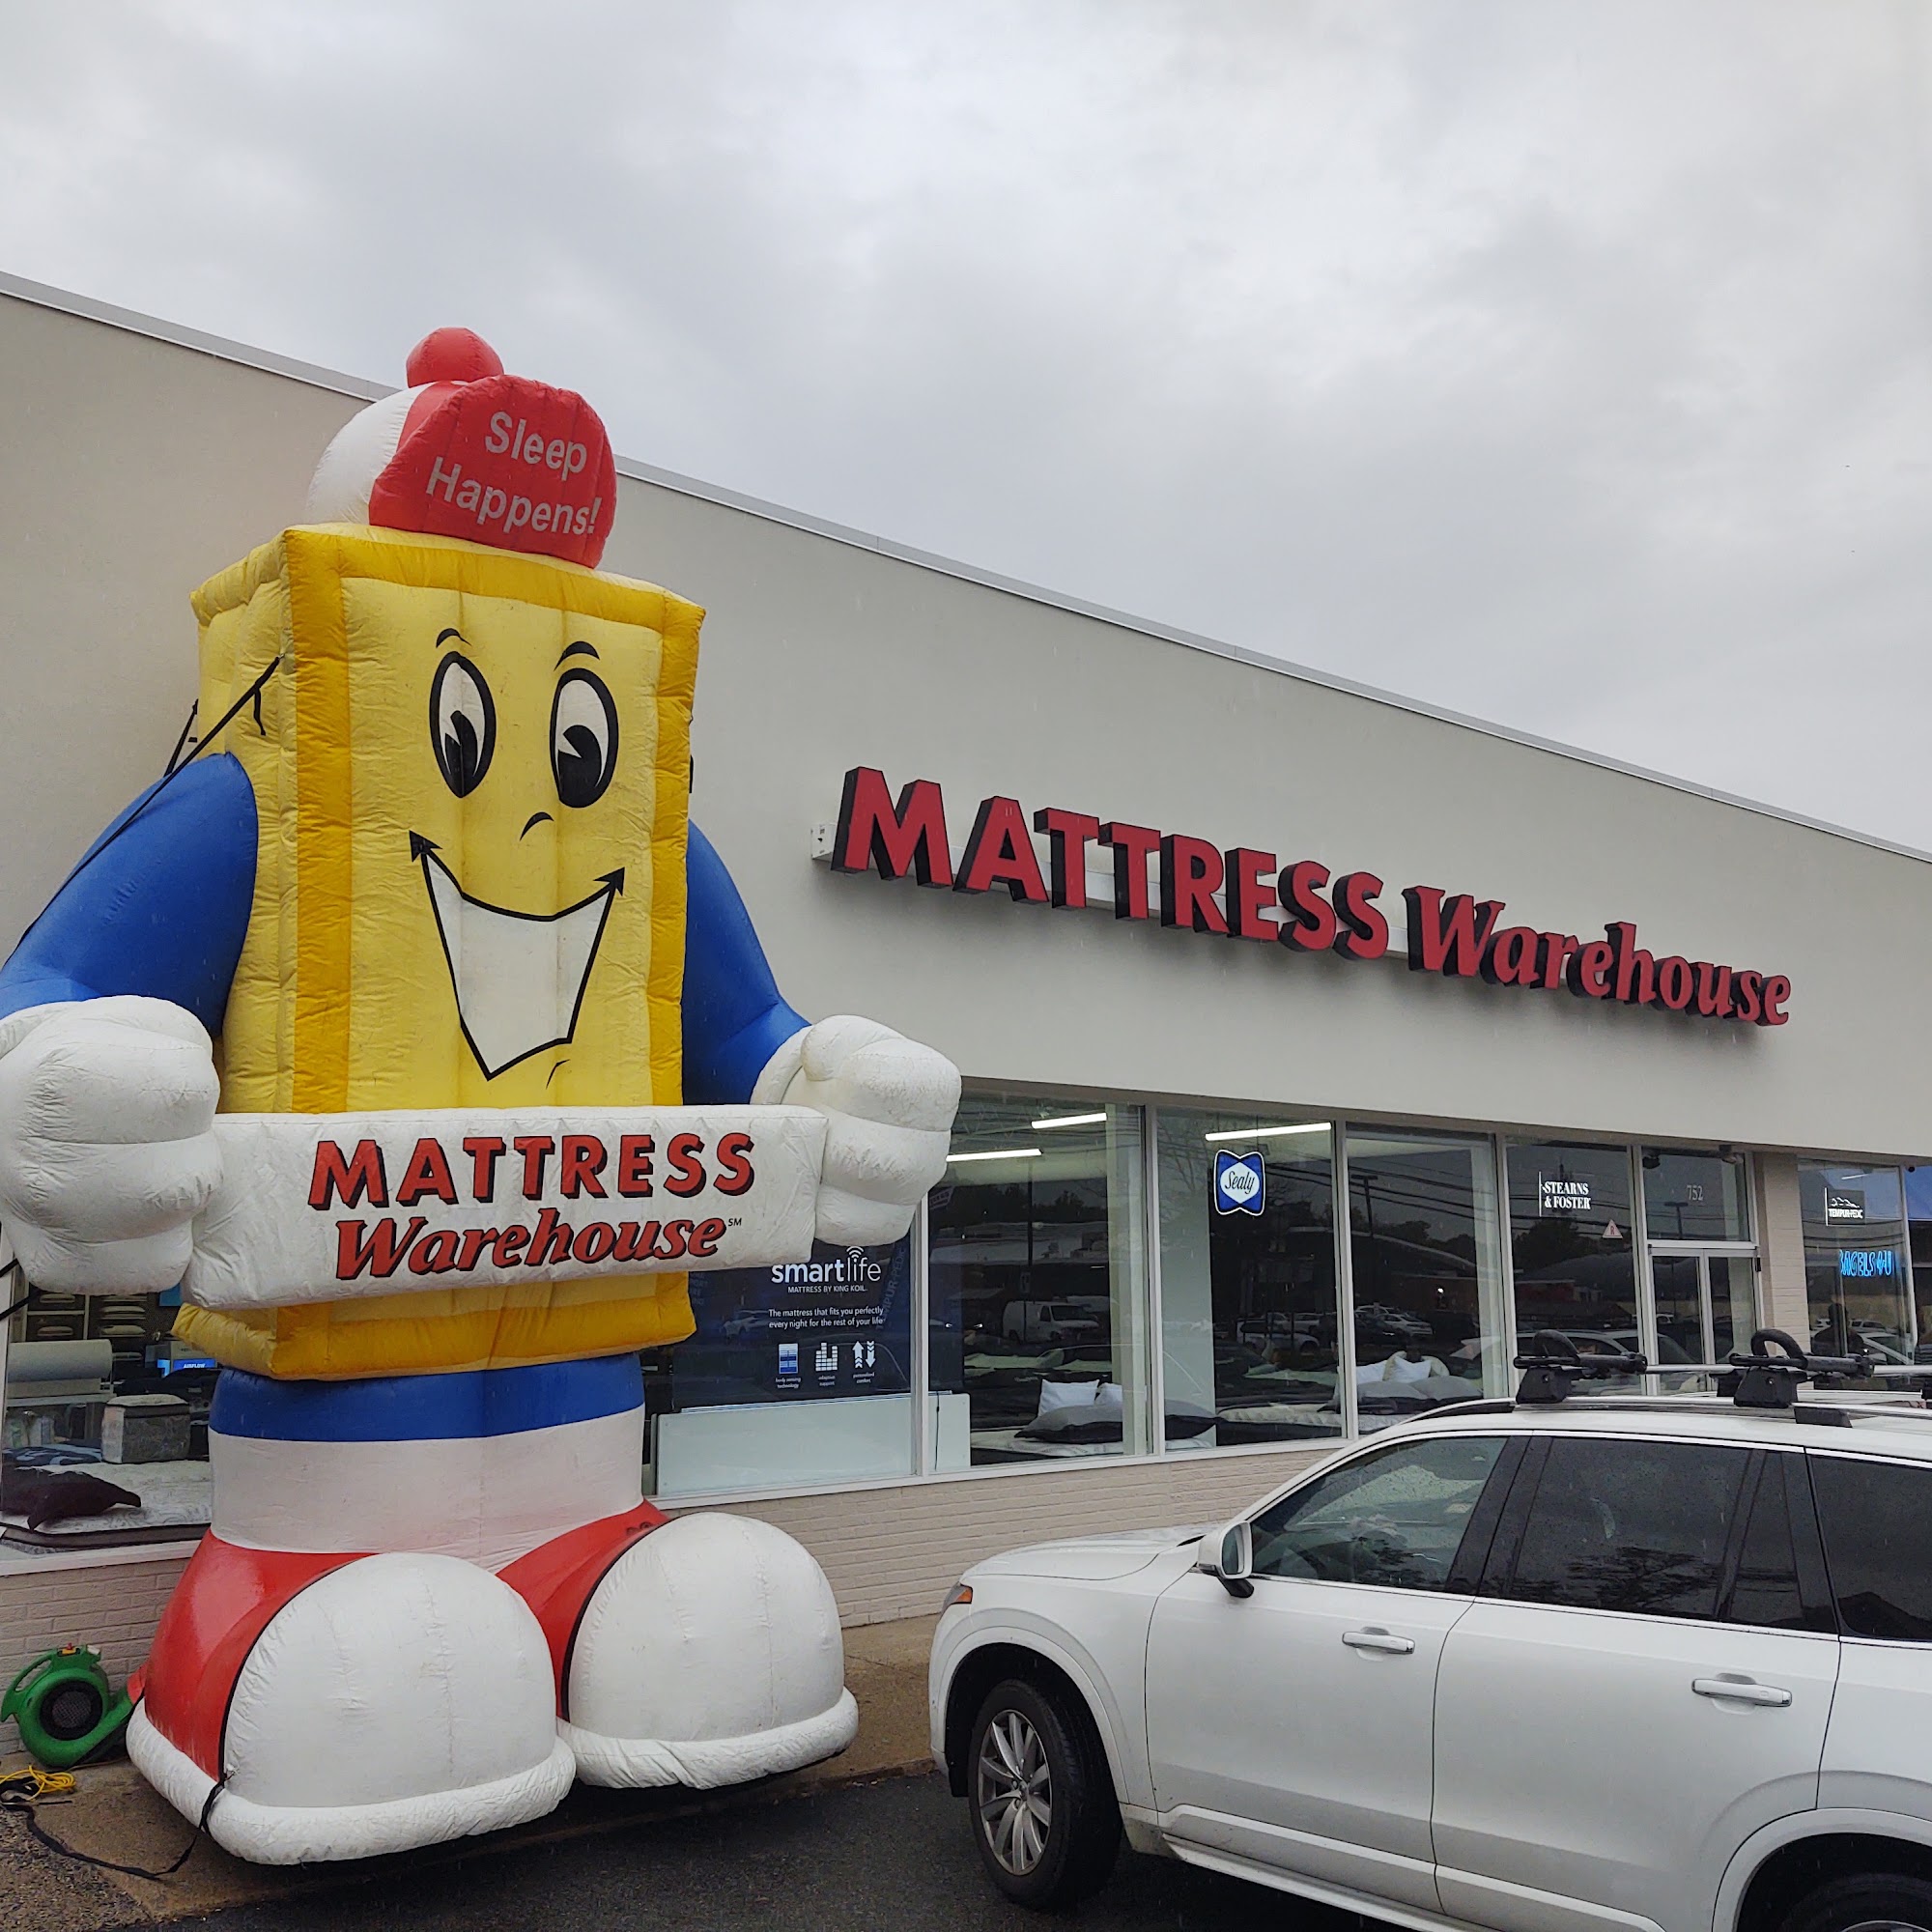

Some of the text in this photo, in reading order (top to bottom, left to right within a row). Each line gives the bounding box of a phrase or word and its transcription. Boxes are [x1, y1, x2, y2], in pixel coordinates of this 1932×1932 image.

[485, 411, 587, 482] Sleep
[425, 456, 603, 535] Happens!
[831, 766, 1791, 1027] MATTRESS Warehouse
[307, 1132, 754, 1211] MATTRESS
[1224, 1170, 1255, 1194] Sealy
[1544, 1180, 1589, 1195] STEARNS
[1687, 1184, 1703, 1201] 752
[1545, 1196, 1591, 1209] & FOSTER
[335, 1207, 727, 1280] Warehouse
[768, 1308, 781, 1317] The
[829, 1307, 839, 1316] fits
[854, 1306, 884, 1317] perfectly
[769, 1321, 788, 1330] every
[789, 1319, 808, 1329] night
[809, 1318, 819, 1326] for
[820, 1318, 832, 1326] the
[833, 1318, 846, 1326] rest
[847, 1317, 855, 1325] of
[856, 1318, 870, 1328] your
